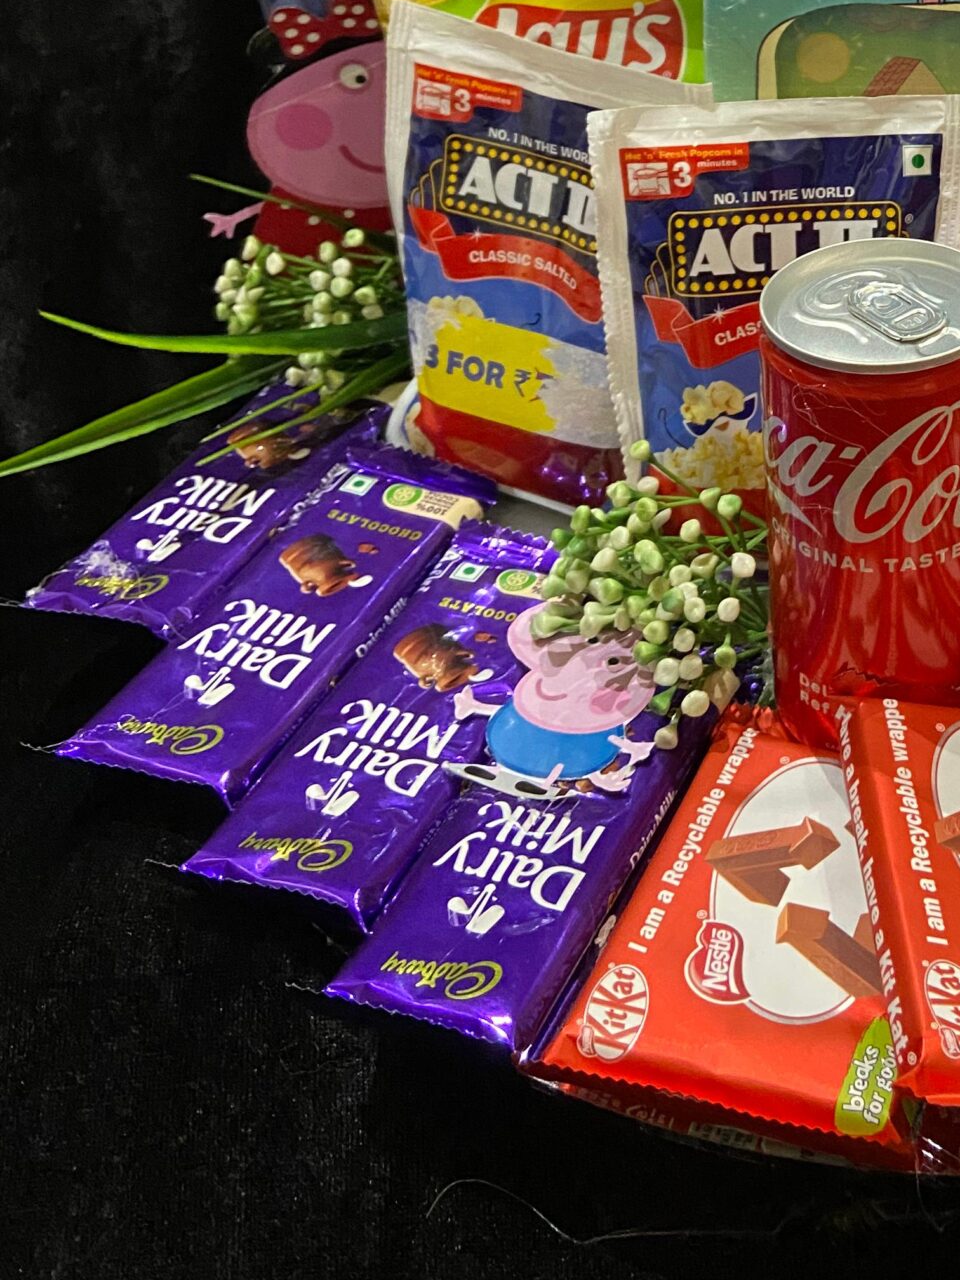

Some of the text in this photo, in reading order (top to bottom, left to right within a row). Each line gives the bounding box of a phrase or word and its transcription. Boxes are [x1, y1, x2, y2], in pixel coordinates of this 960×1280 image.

[453, 88, 472, 113] 3
[487, 126, 510, 143] NO.
[520, 133, 533, 147] IN
[534, 138, 558, 156] THE
[560, 144, 592, 164] WOR
[689, 147, 733, 161] Popcorn
[733, 147, 744, 156] in
[696, 158, 738, 169] minutes
[457, 154, 560, 218] ACT
[671, 160, 693, 189] 3
[713, 185, 856, 205] NO. 1 IN THE WORLD
[467, 249, 578, 291] CLASSIC SALTED
[689, 221, 803, 278] ACT
[713, 320, 763, 346] CLAS
[445, 350, 506, 389] FOR
[174, 474, 277, 517] Milk
[414, 502, 449, 517] 100%
[130, 495, 254, 545] Dairy
[326, 508, 423, 542] CHOCOLATE
[771, 516, 875, 574] ORIGINAL
[223, 597, 338, 654] Milk
[438, 596, 518, 623] OCOLATE
[176, 622, 314, 691] Dairy
[115, 713, 226, 756] Cadbury
[339, 698, 460, 759] Milk
[882, 696, 910, 763] wrappe
[293, 726, 441, 799] Dairy
[715, 726, 760, 787] wrappe
[476, 799, 607, 865] Milk
[660, 785, 727, 888] Recyclable
[846, 776, 870, 864] break,
[892, 764, 935, 874] Recyclable
[237, 830, 355, 873] Cadbury
[431, 830, 588, 913] Dairy
[655, 888, 676, 906] a
[860, 857, 882, 926] have
[918, 877, 938, 894] a
[639, 906, 667, 941] am
[922, 895, 947, 934] am
[873, 926, 885, 950] a
[379, 950, 504, 1001] Cadbury
[877, 946, 898, 997] Kit
[590, 968, 648, 1053] KitKat
[886, 995, 910, 1065] Kat.
[841, 1045, 881, 1113] breaks
[862, 1090, 886, 1125] for
